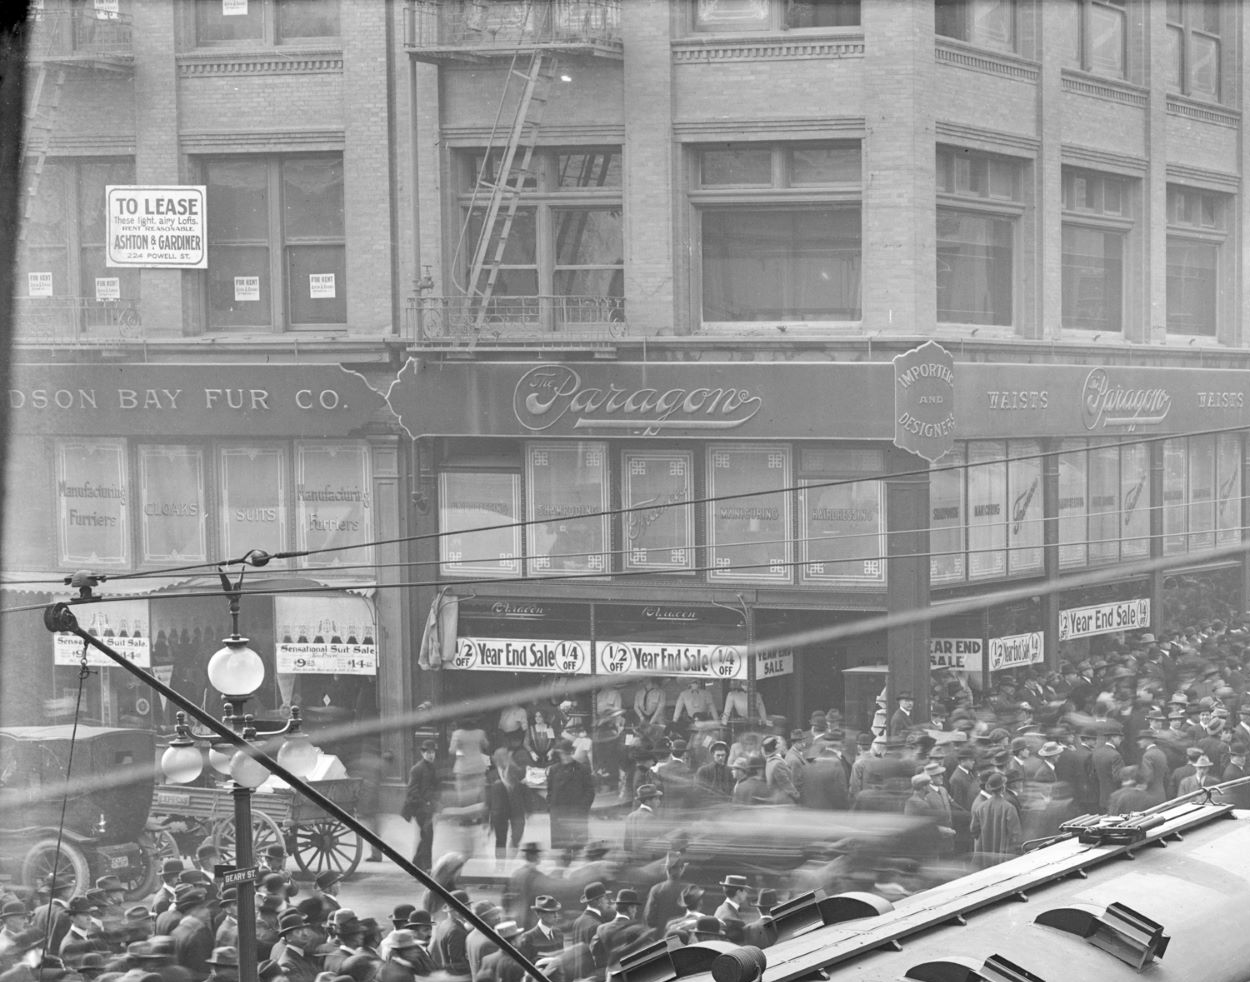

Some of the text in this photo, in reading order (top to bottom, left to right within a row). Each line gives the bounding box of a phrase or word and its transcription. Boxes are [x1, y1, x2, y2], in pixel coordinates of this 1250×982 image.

[115, 198, 199, 216] TO LEASE
[114, 216, 135, 225] These
[158, 217, 176, 228] airy
[114, 234, 201, 251] ASHTON & GARDINER
[147, 252, 177, 260] POWELL
[117, 389, 183, 409] BAY
[204, 388, 270, 409] FUR
[294, 389, 349, 409] CO.
[513, 364, 762, 436] Paragon
[919, 396, 944, 404] AND
[58, 480, 127, 505] Manufacturing
[144, 503, 199, 517] CLOAKS
[235, 507, 276, 522] SUITS
[69, 508, 118, 528] Furriers
[309, 512, 360, 532] Furriers
[1070, 613, 1093, 633] Year
[1095, 610, 1114, 629] End
[1116, 605, 1136, 626] Sale
[281, 644, 328, 653] Sensational
[330, 645, 350, 653] Suit
[956, 640, 981, 654] END
[455, 657, 470, 667] OFF
[478, 642, 503, 666] Year
[506, 642, 528, 667] End
[529, 643, 555, 668] Sale
[562, 644, 578, 660] 1/4
[609, 645, 628, 662] 1/2
[632, 647, 660, 670] Year
[661, 648, 682, 671] End
[683, 648, 709, 672] Sale
[563, 661, 577, 670] OFF
[609, 662, 624, 672] OFF
[719, 666, 733, 676] OFF
[765, 660, 784, 675] SALE
[225, 872, 246, 883] GEARY
